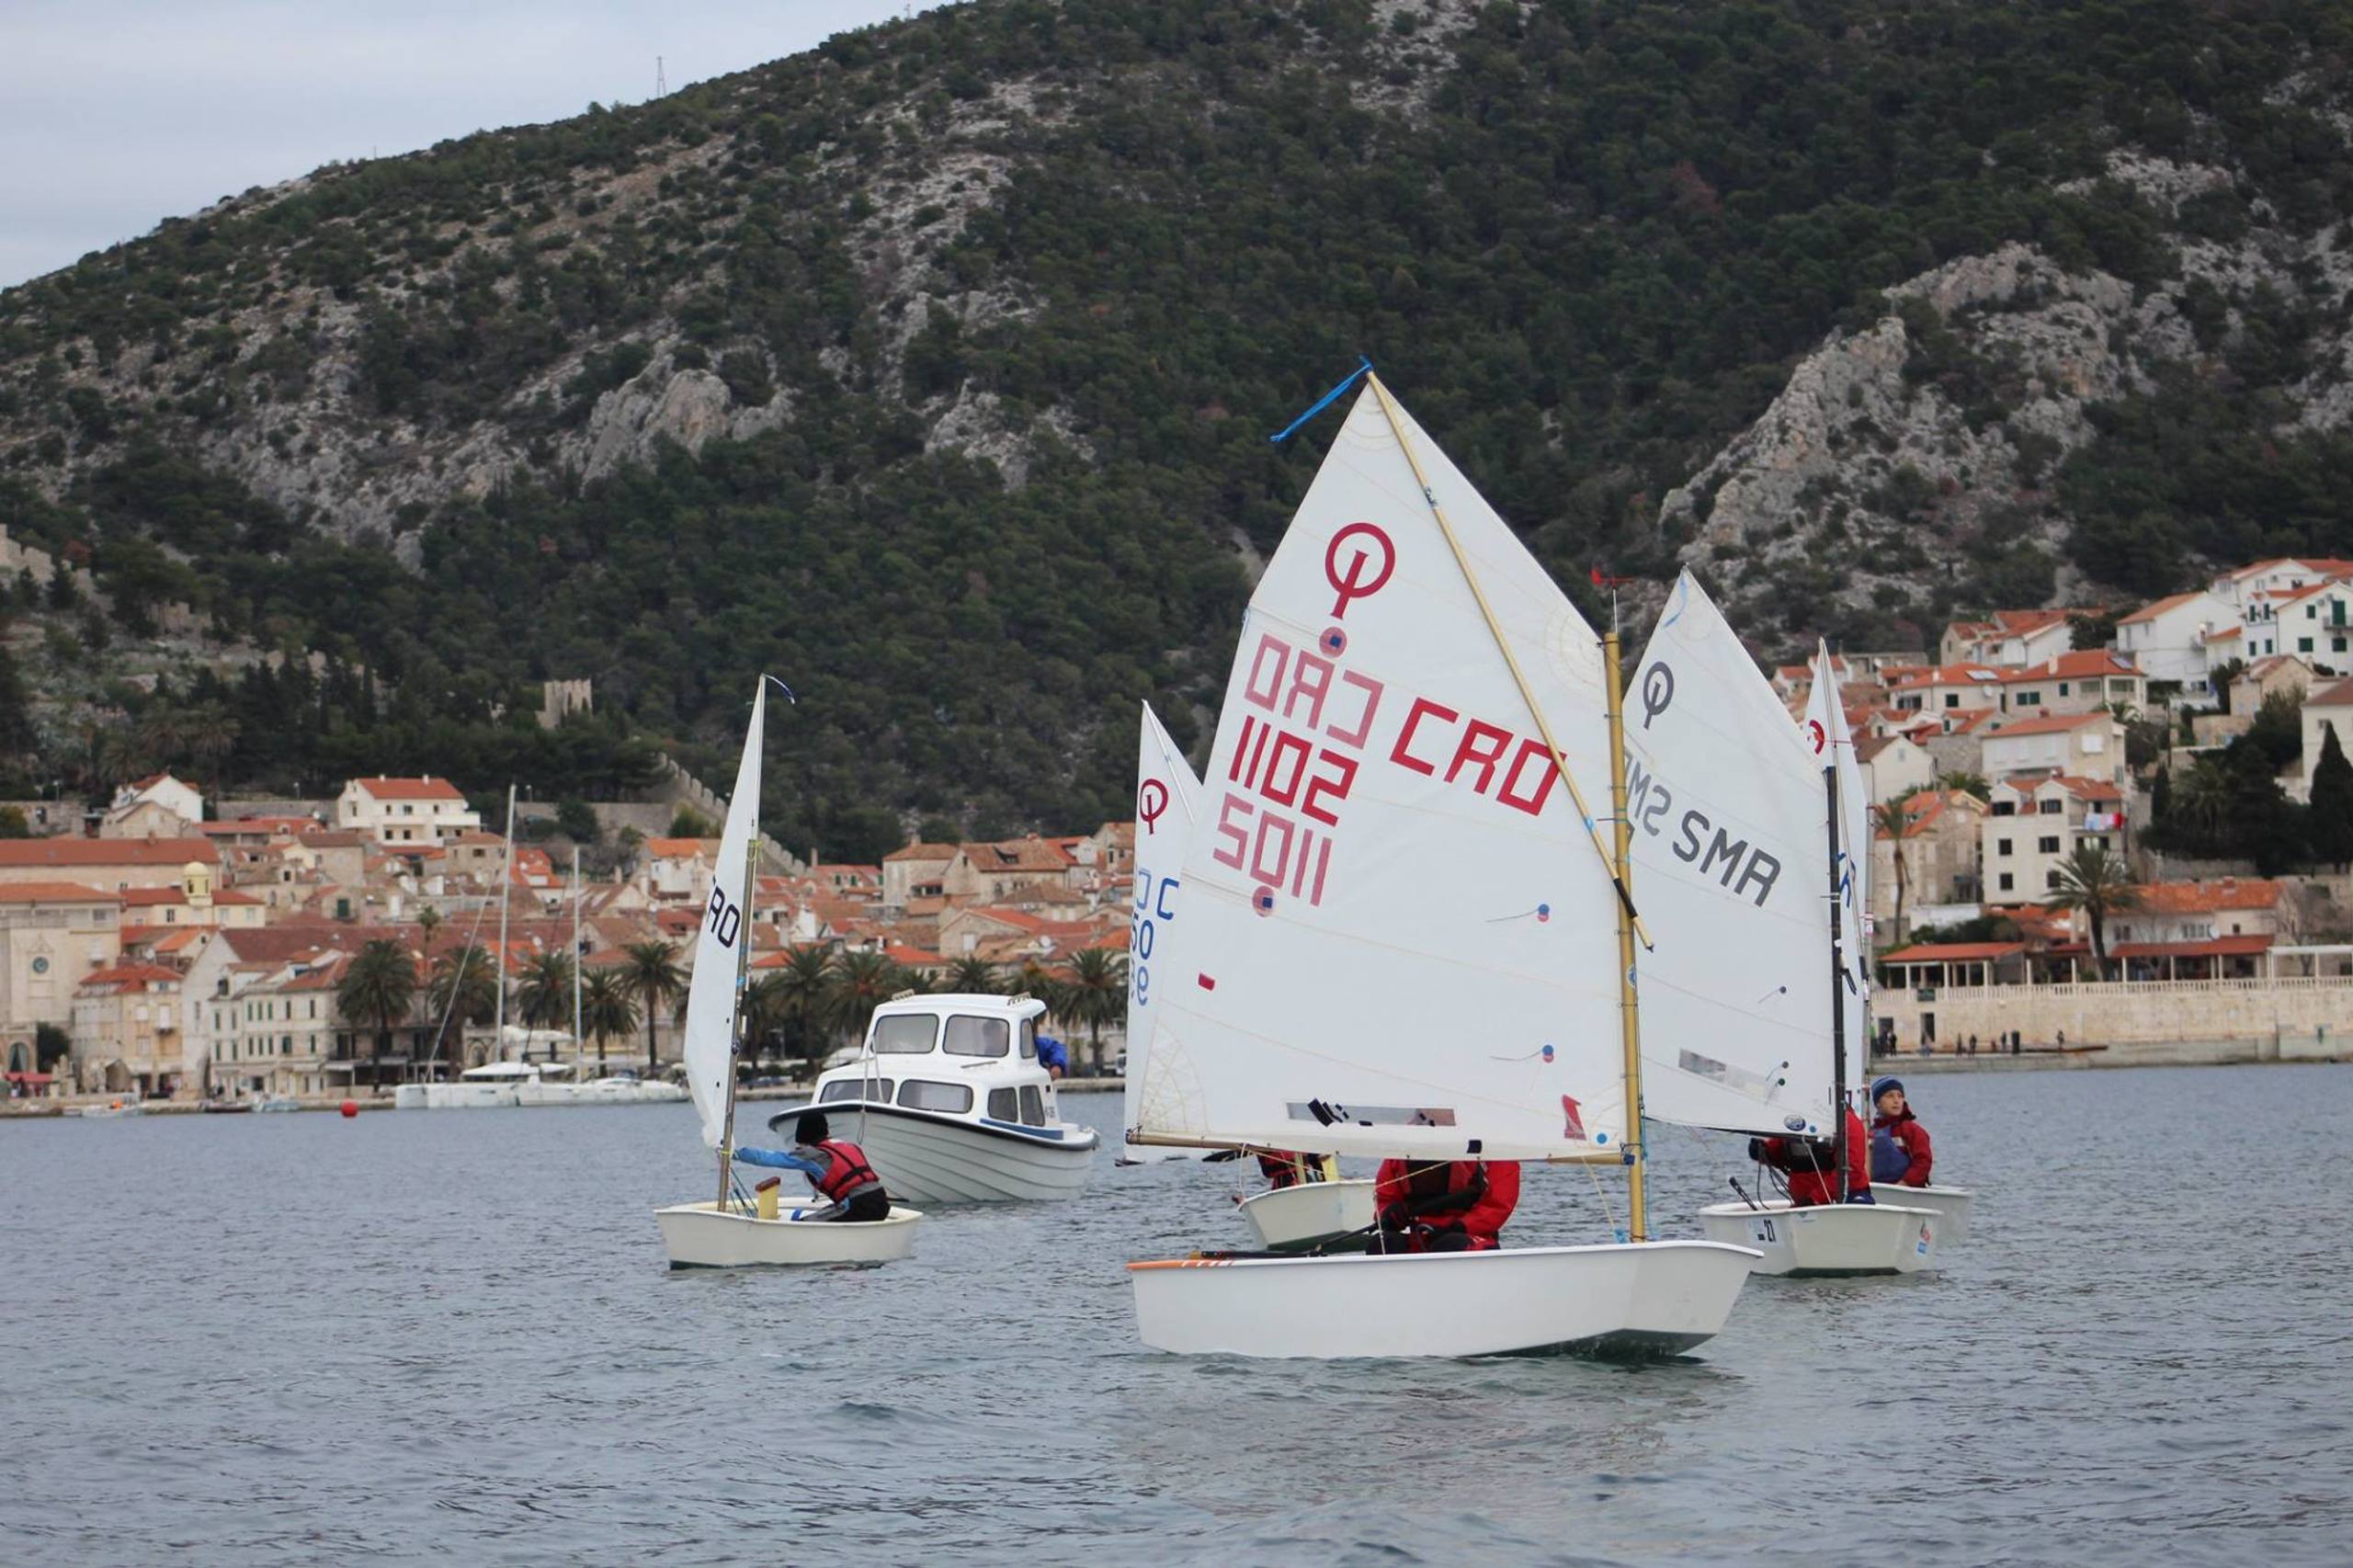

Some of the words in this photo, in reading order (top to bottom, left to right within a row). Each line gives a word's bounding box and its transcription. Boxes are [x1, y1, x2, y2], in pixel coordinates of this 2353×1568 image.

[1228, 714, 1360, 828] 1102
[1390, 696, 1566, 817] CRO
[706, 874, 741, 949] RO
[1672, 809, 1781, 908] SMR
